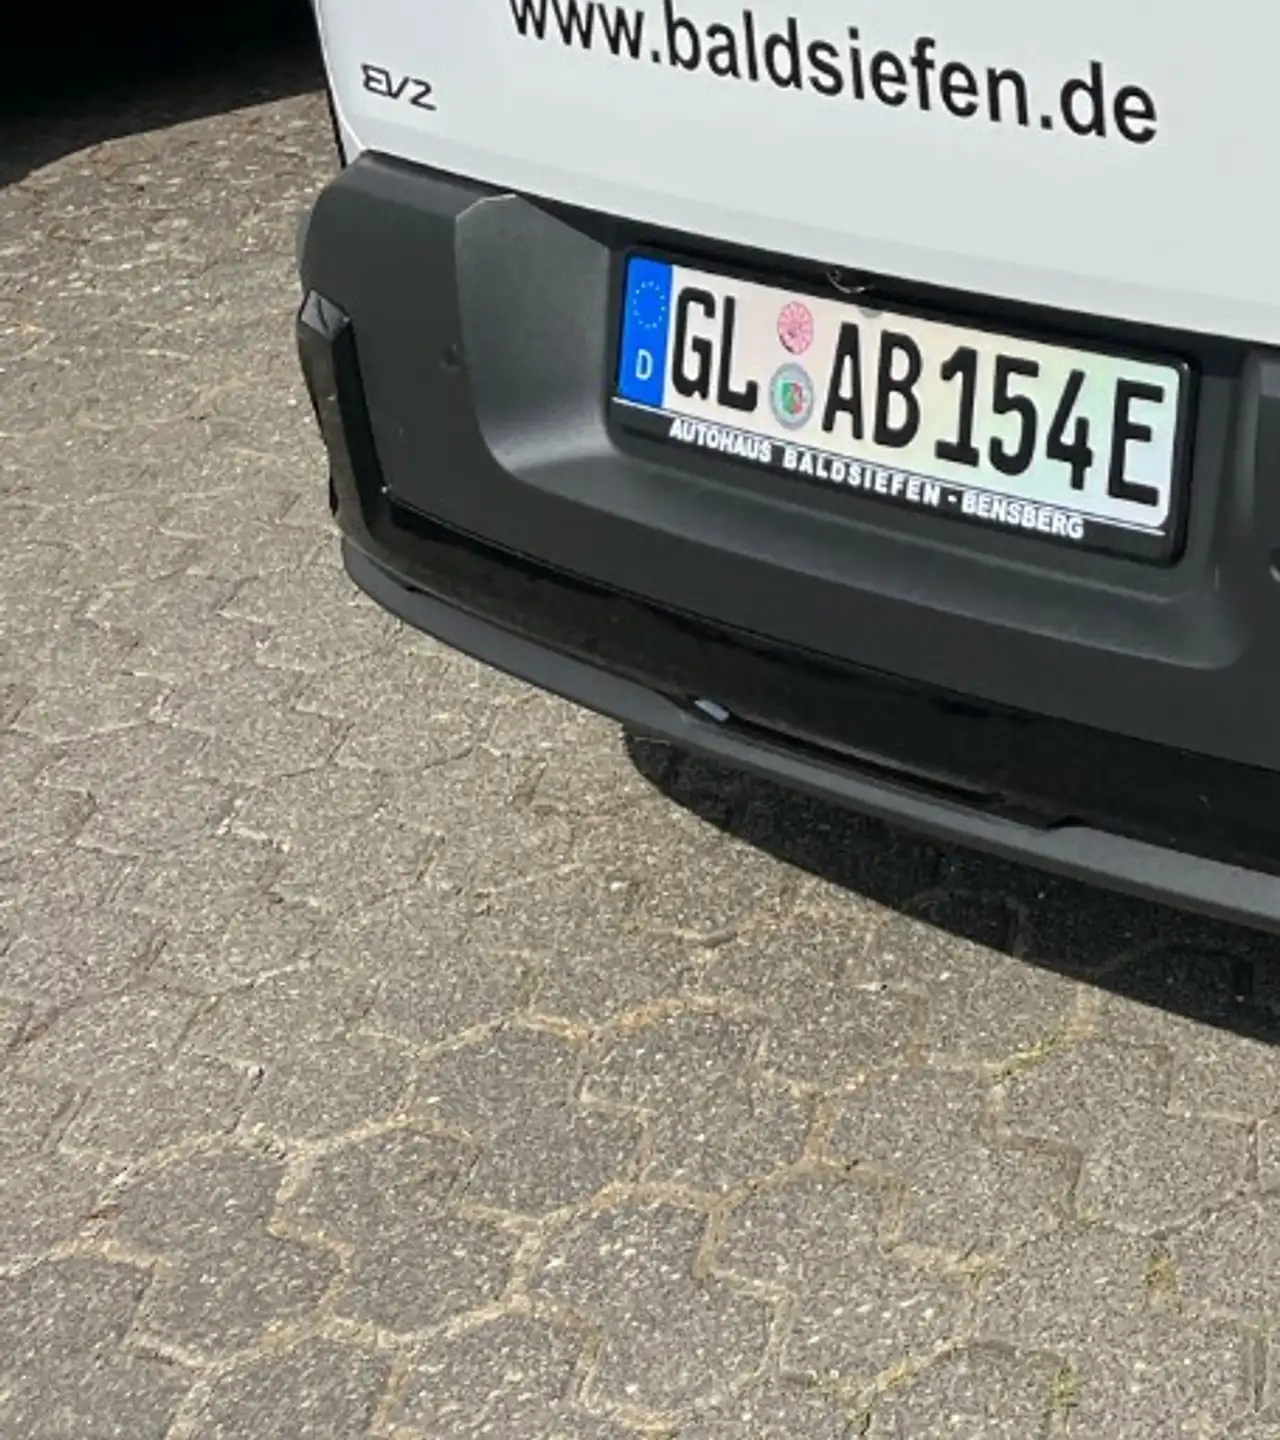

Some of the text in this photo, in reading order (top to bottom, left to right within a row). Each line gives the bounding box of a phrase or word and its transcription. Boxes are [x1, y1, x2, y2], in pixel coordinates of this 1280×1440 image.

[361, 63, 438, 111] EV2
[634, 350, 654, 381] D
[670, 286, 759, 413] GL
[669, 416, 773, 464] AUTOHAUS
[781, 444, 942, 508] BALDSIEFEN
[961, 491, 1086, 540] BENSBERG
